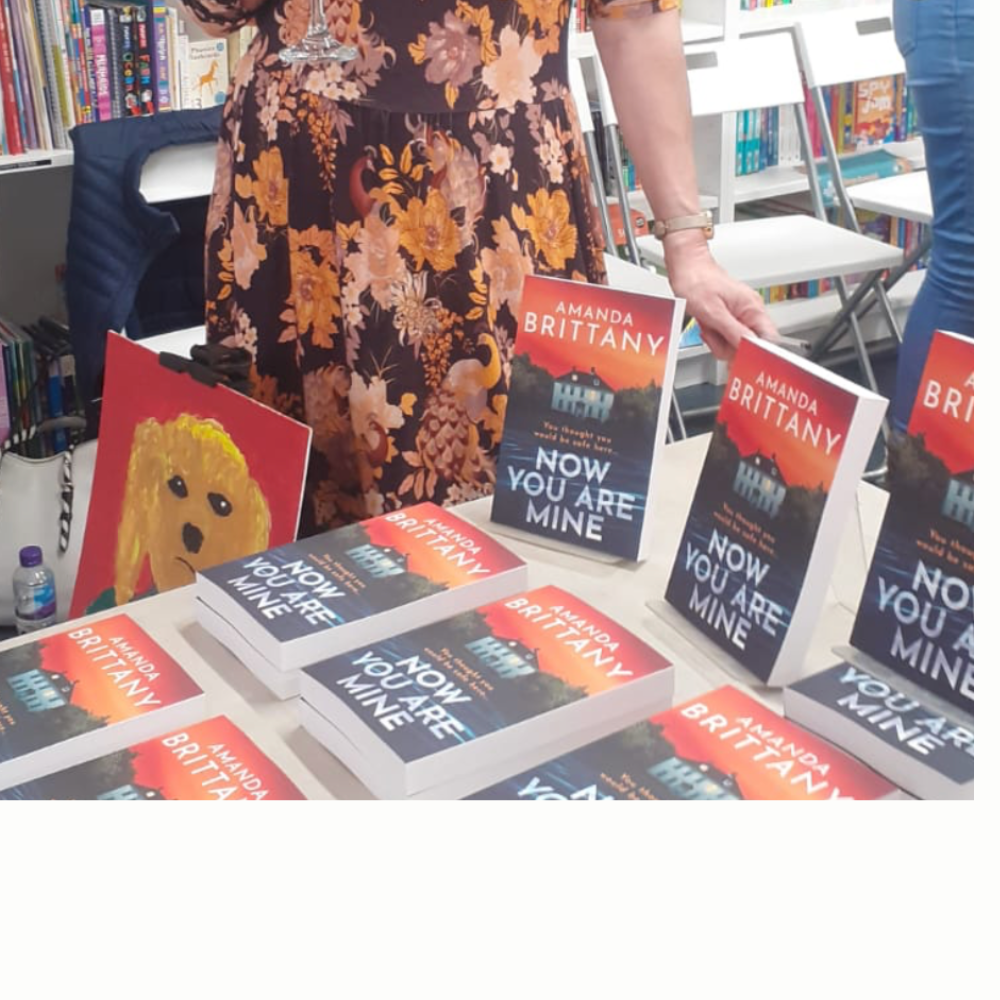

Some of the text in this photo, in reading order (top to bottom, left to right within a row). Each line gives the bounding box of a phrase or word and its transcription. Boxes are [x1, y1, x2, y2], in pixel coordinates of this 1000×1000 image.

[523, 312, 664, 356] BRITTANY
[555, 301, 633, 326] AMANDA
[729, 377, 841, 455] BRITTANY
[756, 371, 818, 416] AMANDA
[535, 446, 611, 483] NOW
[507, 466, 636, 521] YOU ARE
[526, 498, 604, 541] MINE
[384, 512, 491, 575] BRITTANY
[423, 518, 482, 555] AMANDA
[708, 528, 770, 586] NOW
[228, 575, 294, 619] MINE
[243, 556, 337, 625] YOU ARE
[282, 560, 346, 599] NOW
[685, 542, 783, 637] YOU ARE
[878, 576, 947, 638] YOU
[912, 559, 974, 610] NO
[504, 597, 634, 678] BRITTANY
[549, 605, 620, 653] AMANDA
[689, 583, 752, 650] MINE
[68, 627, 161, 708] BRITTANY
[108, 636, 161, 682] AMANDA
[395, 655, 472, 705] NOW
[336, 672, 415, 732] MINE
[352, 651, 466, 740] YOU ARE
[839, 666, 919, 712] YOU
[736, 715, 830, 777] AMANDA
[836, 693, 945, 755] MINE
[162, 732, 250, 800] BRITTA
[207, 743, 269, 800] AMANDA
